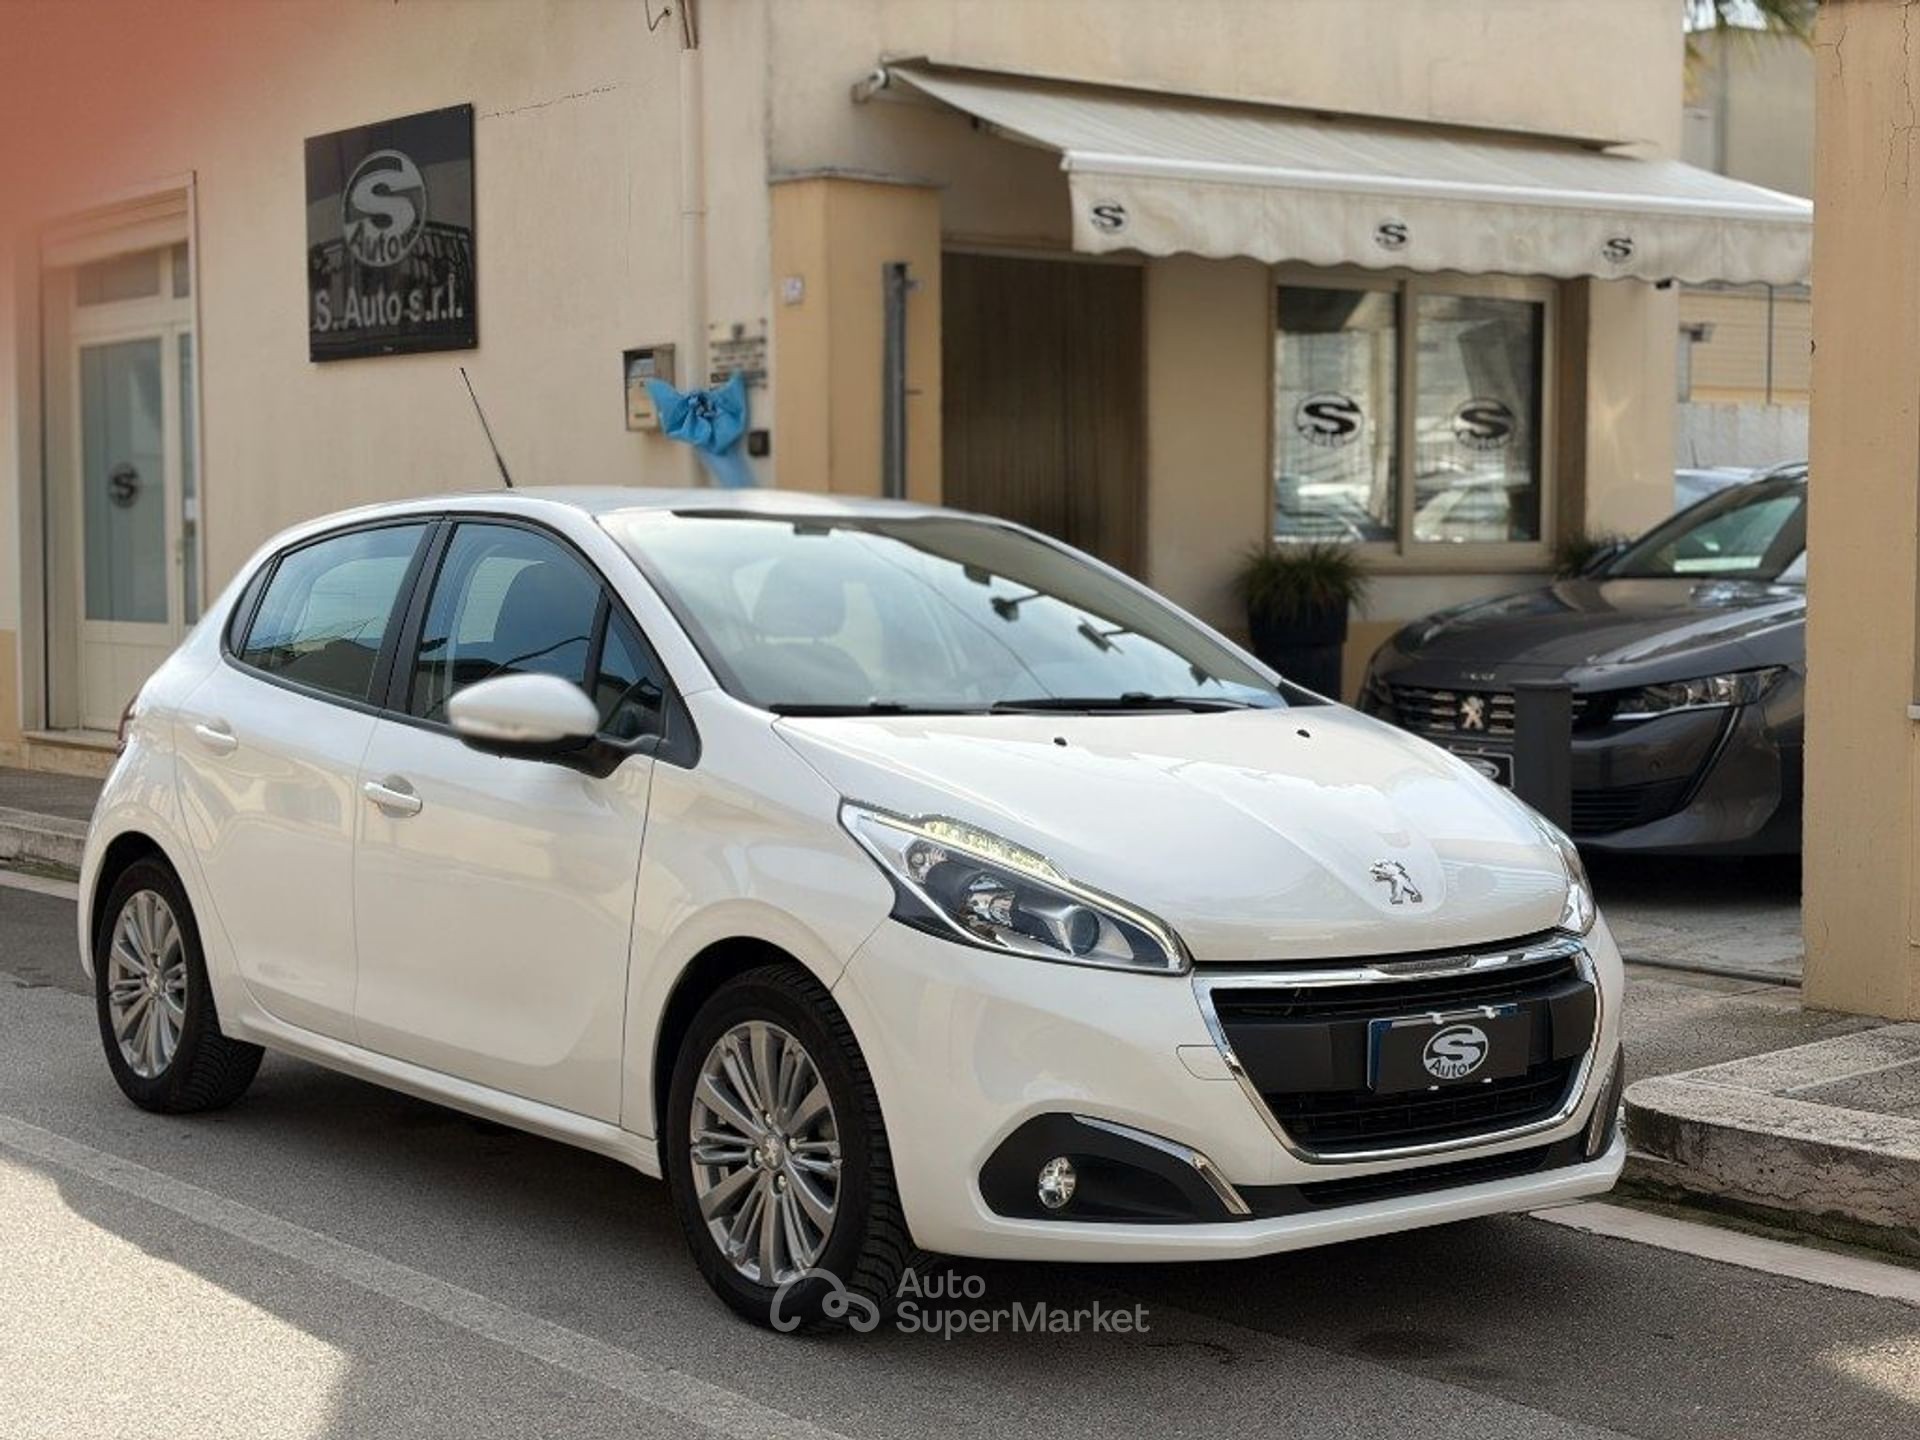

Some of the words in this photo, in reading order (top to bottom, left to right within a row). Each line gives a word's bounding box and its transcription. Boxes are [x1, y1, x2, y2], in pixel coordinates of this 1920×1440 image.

[351, 156, 424, 234] S
[344, 288, 401, 328] Auto
[408, 272, 465, 323] s.r.l.
[1431, 1029, 1488, 1062] S
[1429, 1058, 1469, 1078] Auto
